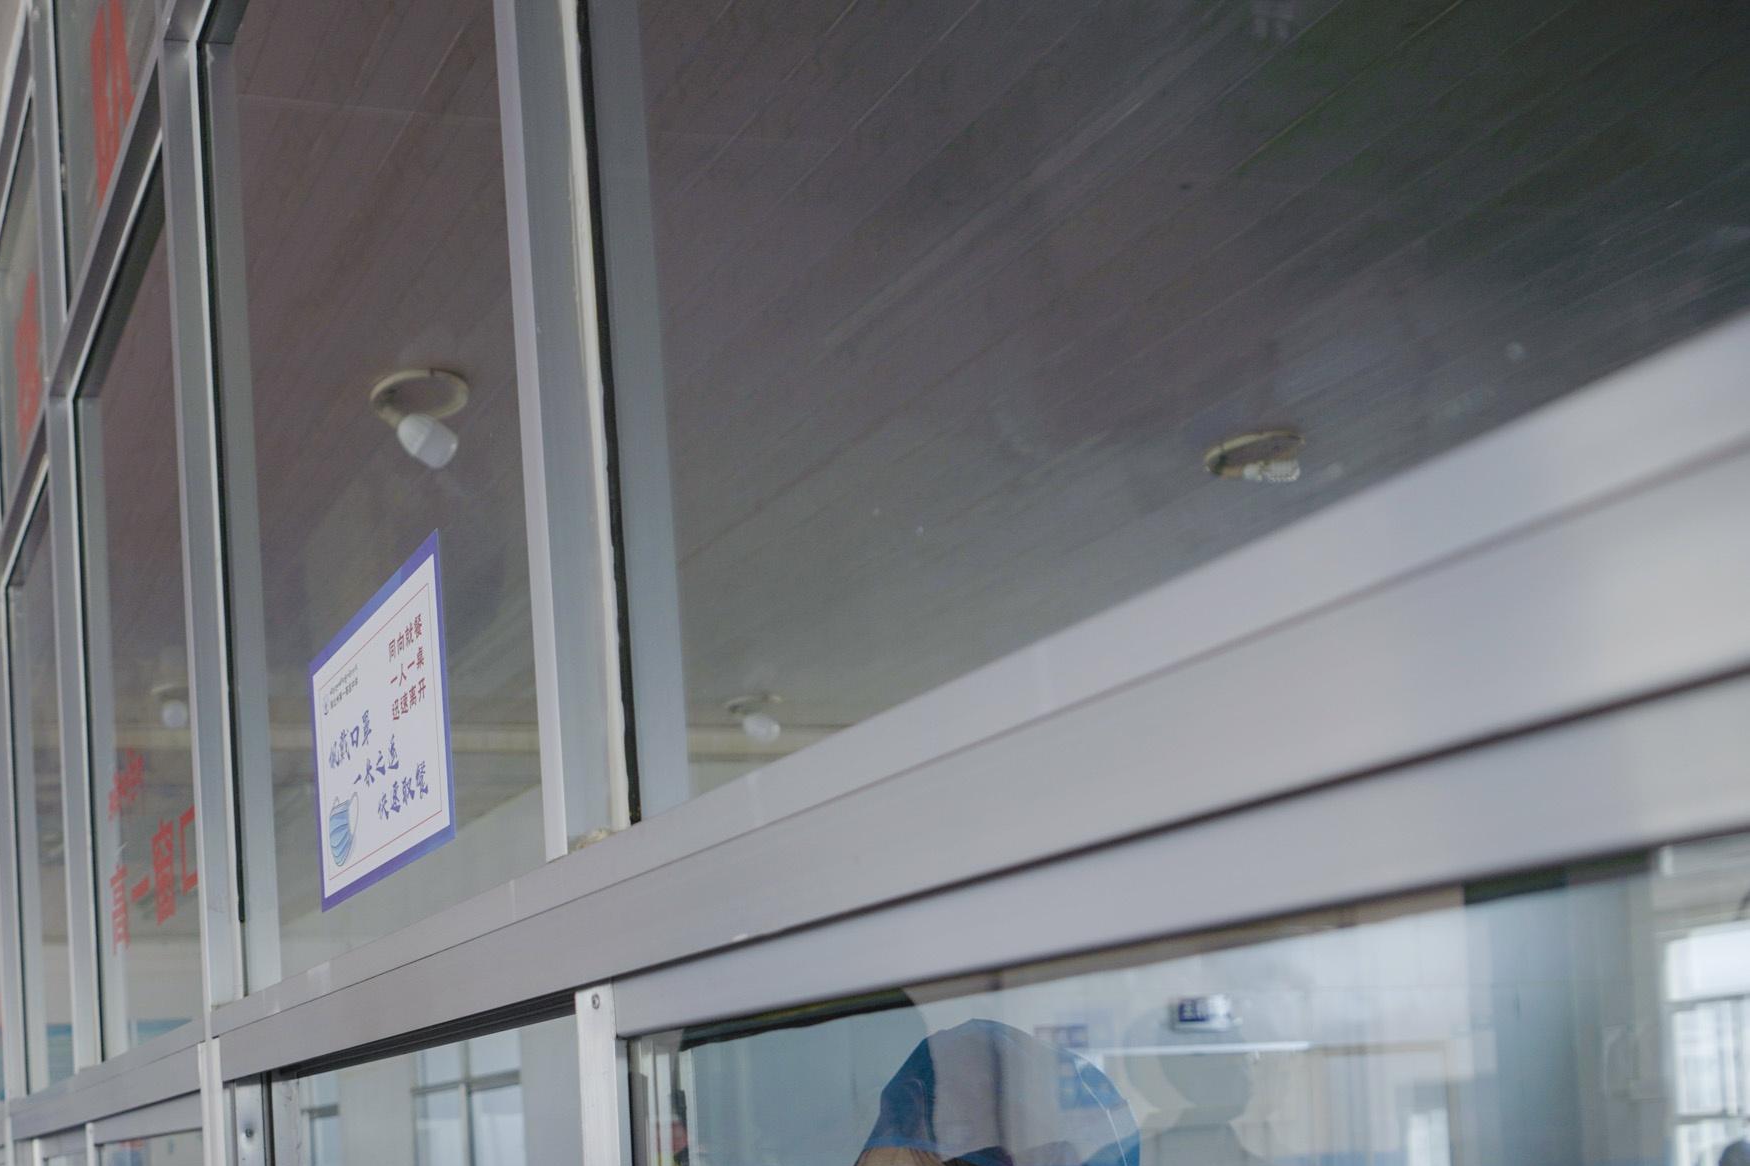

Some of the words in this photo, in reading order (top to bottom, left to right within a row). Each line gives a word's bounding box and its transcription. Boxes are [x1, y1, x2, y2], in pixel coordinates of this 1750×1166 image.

[388, 613, 423, 663] 同向就餐
[390, 646, 425, 688] 一人一桌
[391, 677, 427, 721] 迅速离开
[328, 709, 372, 769] 佩戴口罩
